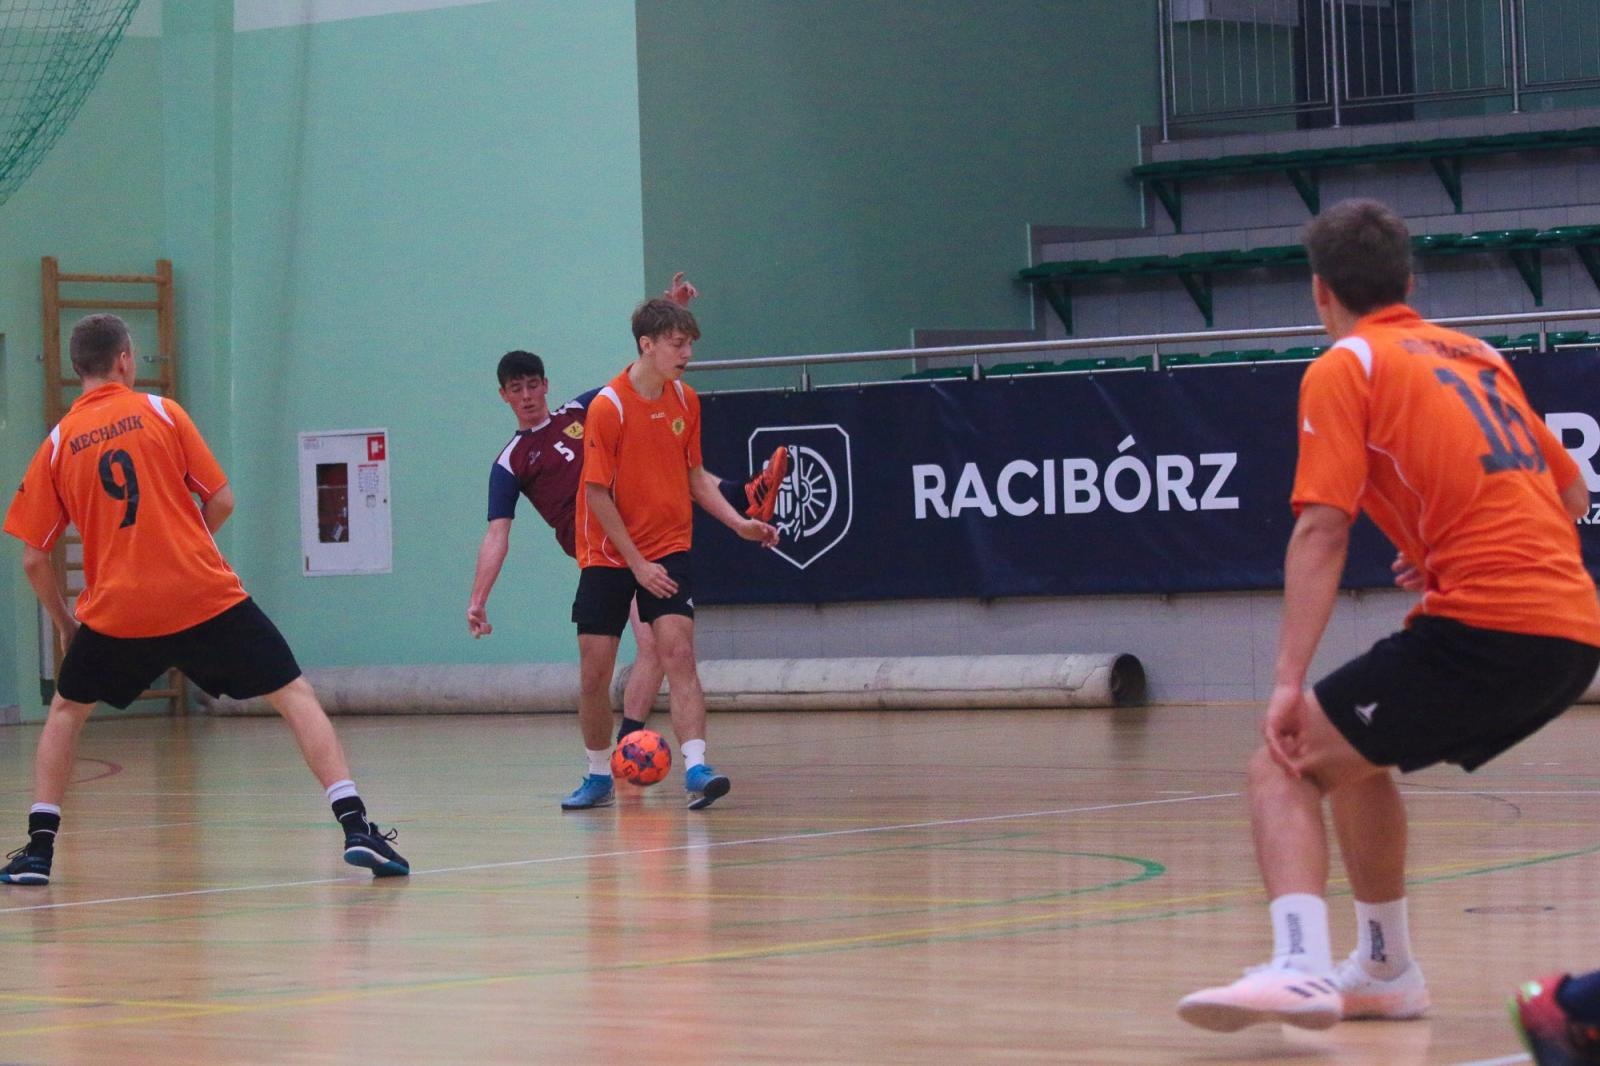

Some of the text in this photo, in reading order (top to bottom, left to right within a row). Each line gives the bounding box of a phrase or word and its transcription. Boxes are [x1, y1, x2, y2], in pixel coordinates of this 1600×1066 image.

[69, 415, 144, 455] MECHANIK
[553, 440, 575, 462] 5
[1433, 366, 1547, 475] 16
[98, 449, 140, 529] 9
[912, 434, 1240, 519] RACIBÓRZ
